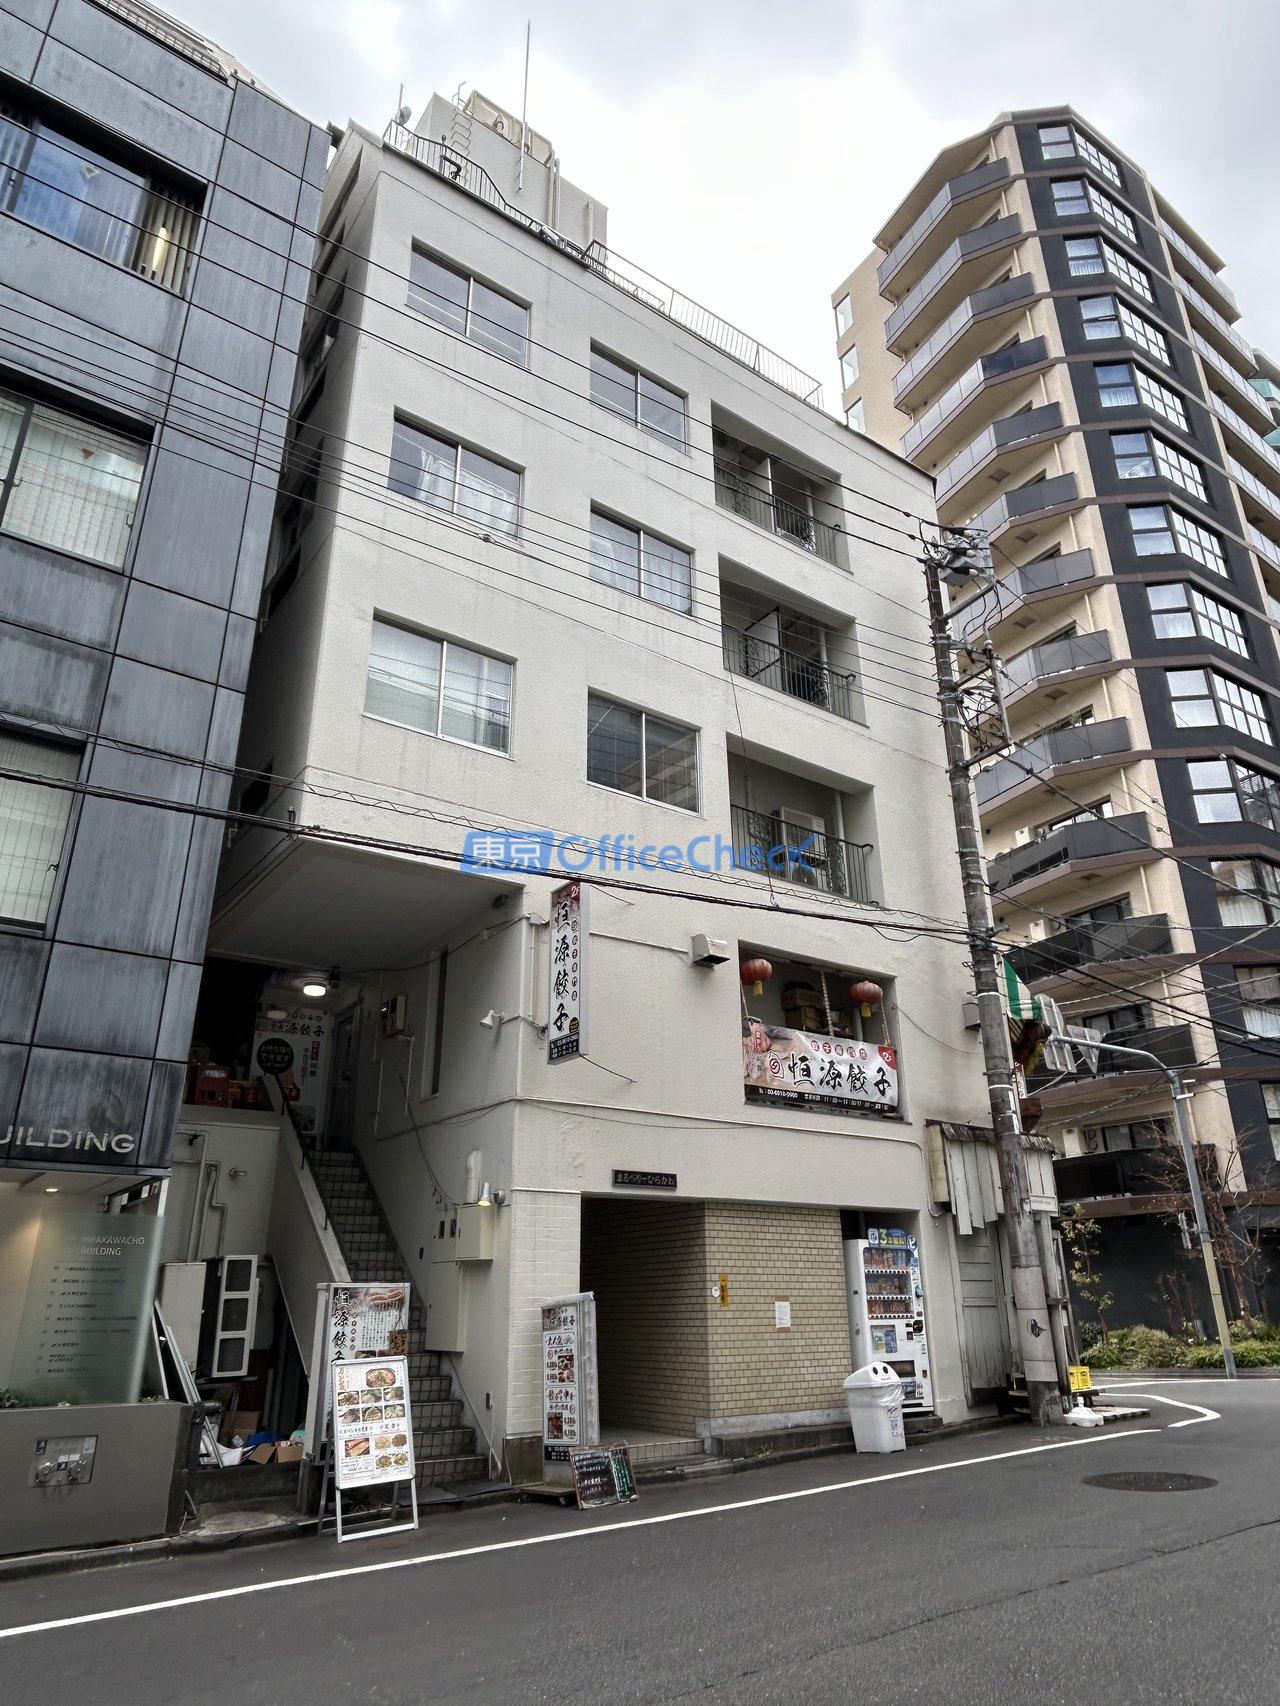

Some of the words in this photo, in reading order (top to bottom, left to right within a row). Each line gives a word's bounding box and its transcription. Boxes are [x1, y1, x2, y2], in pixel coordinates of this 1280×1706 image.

[554, 902, 572, 1032] 恒源餃子
[787, 1053, 892, 1097] 恒源餃子
[81, 1246, 122, 1256] BUILDING
